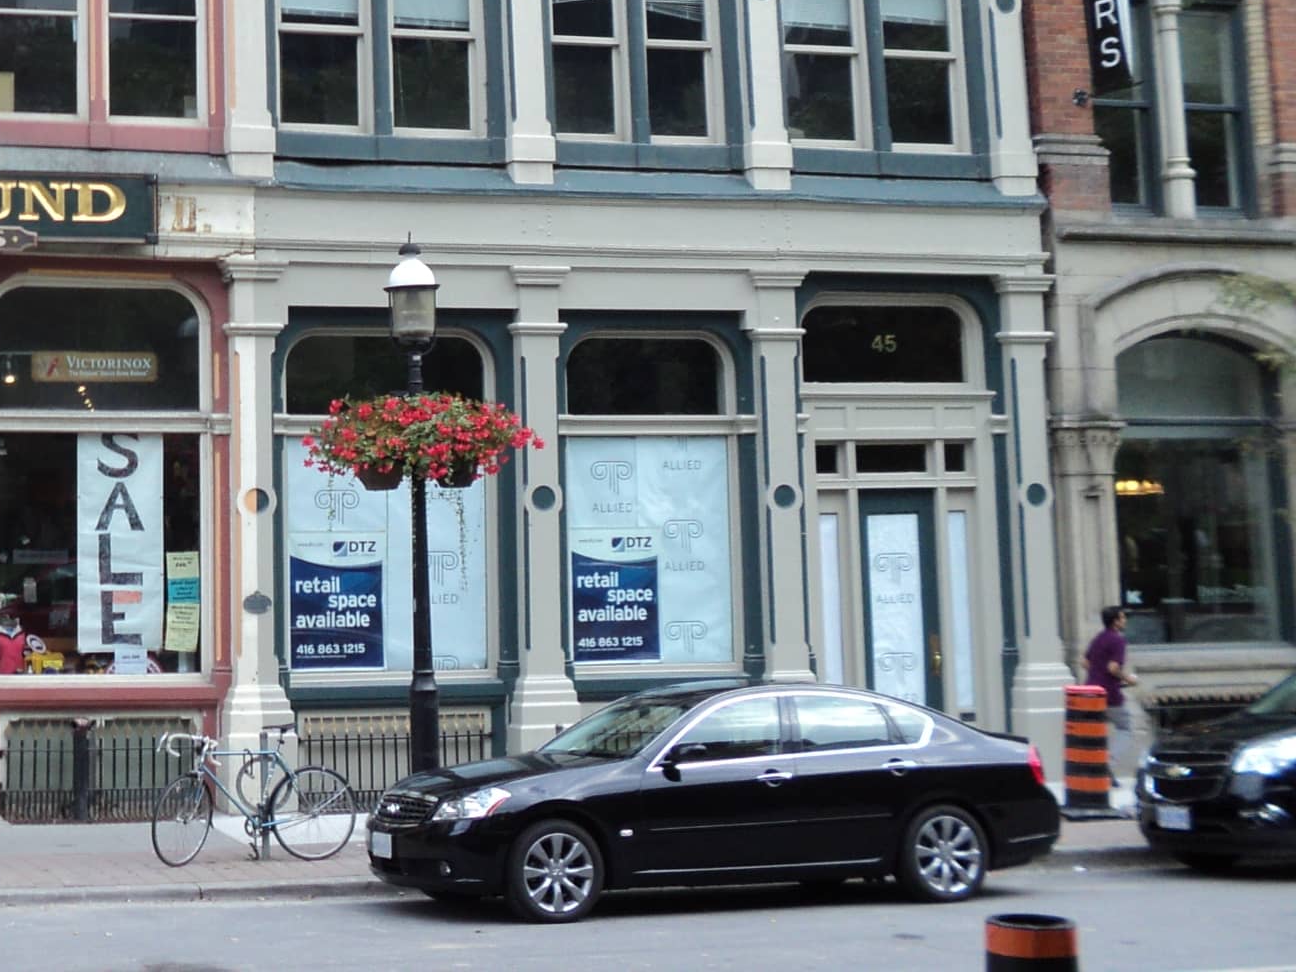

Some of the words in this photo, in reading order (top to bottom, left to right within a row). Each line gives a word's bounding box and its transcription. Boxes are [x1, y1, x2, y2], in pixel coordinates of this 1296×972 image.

[871, 334, 897, 353] 45
[66, 356, 152, 370] VICTORINOX
[662, 459, 702, 470] ALLIED
[591, 502, 632, 513] ALLIED
[95, 433, 144, 646] SALE
[348, 541, 376, 553] DTZ
[626, 537, 652, 548] DTZ
[664, 560, 705, 571] ALLIED
[295, 576, 340, 594] retail
[576, 572, 618, 588] retail
[328, 594, 377, 610] space
[607, 588, 653, 604] space
[295, 611, 370, 628] available
[577, 605, 647, 622] available
[296, 644, 314, 655] 416
[317, 644, 339, 654] 863
[343, 643, 365, 654] 1215
[577, 637, 596, 648] 416
[598, 637, 619, 647] 863
[622, 636, 643, 646] 1215
